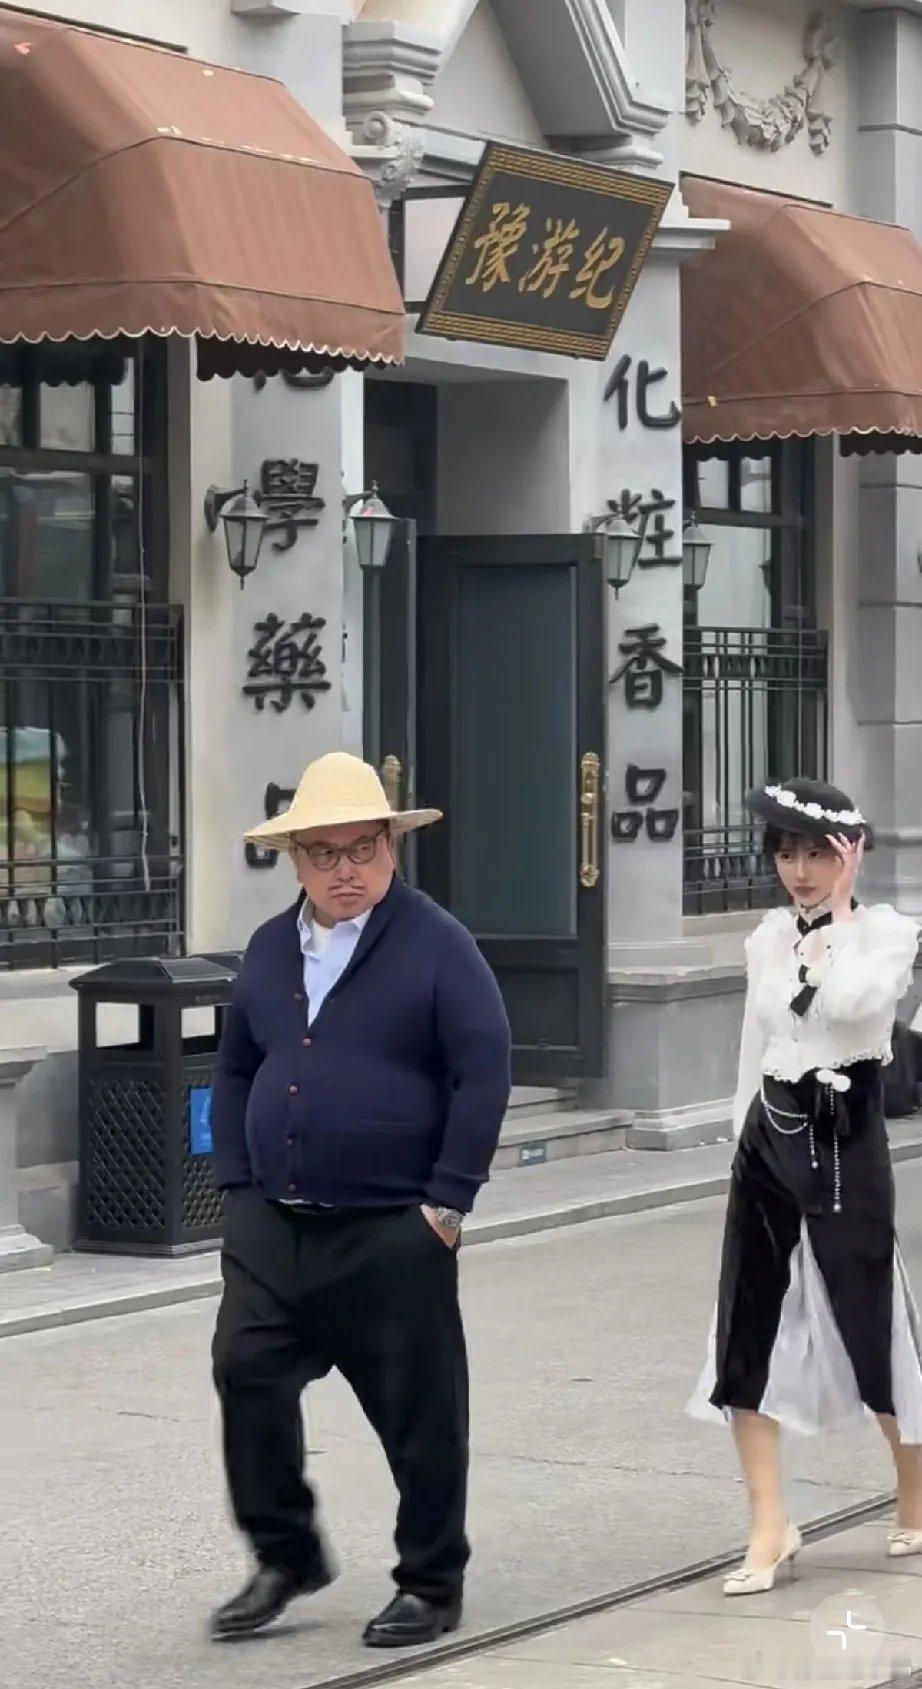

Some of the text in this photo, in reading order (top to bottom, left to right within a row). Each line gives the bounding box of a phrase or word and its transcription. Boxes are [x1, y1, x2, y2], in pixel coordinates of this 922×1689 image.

[243, 366, 333, 869] 學藥
[604, 353, 684, 843] 化粧香品
